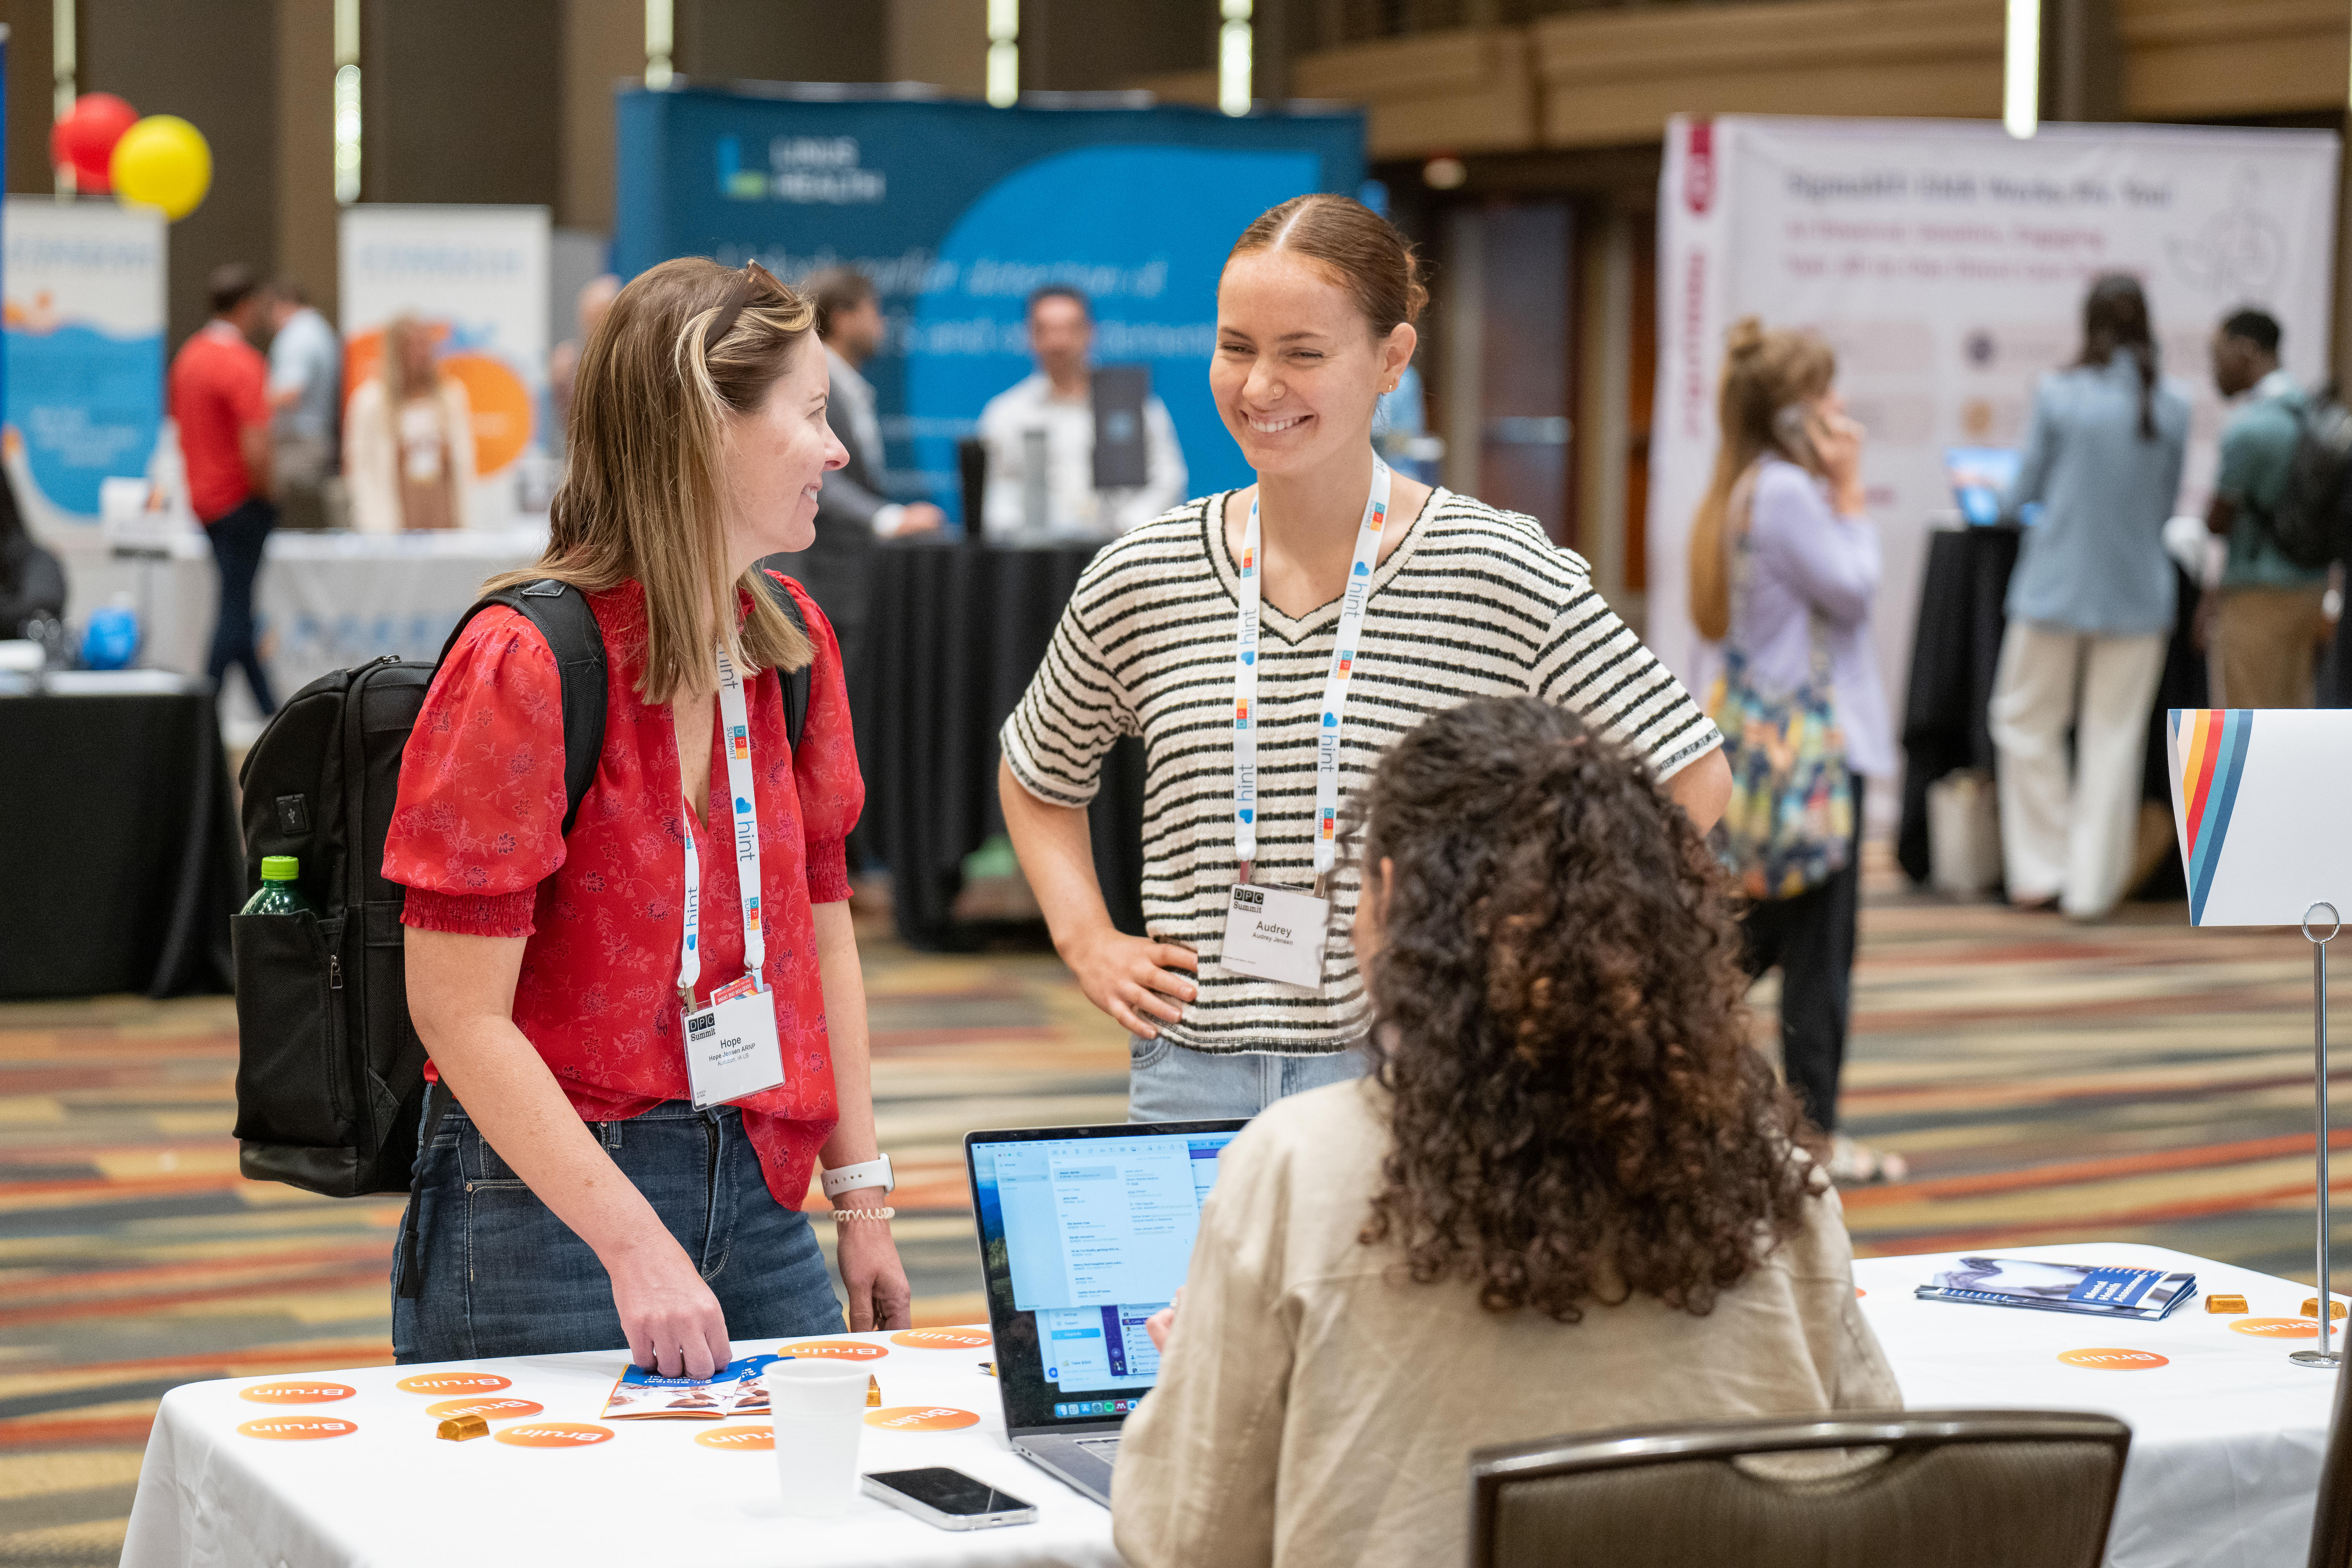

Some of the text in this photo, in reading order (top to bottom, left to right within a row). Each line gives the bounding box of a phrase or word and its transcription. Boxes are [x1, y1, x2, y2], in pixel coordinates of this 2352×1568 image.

[1345, 582, 1368, 618] hint
[1240, 608, 1256, 645] hint
[1332, 649, 1342, 679] SUMMIT
[726, 727, 736, 760] SUMMIT
[736, 727, 746, 758] DPC
[1321, 735, 1338, 773] hint
[1237, 764, 1254, 801] hint
[1325, 809, 1333, 838] DPC
[738, 820, 755, 862] hint
[1235, 889, 1263, 904] DPC
[686, 886, 697, 927] hint
[1233, 902, 1262, 913] Summit
[1256, 921, 1292, 938] Audrey
[1252, 932, 1293, 945] Audrey Jensen
[742, 983, 751, 992] GOOD
[717, 994, 728, 1003] DRINK
[690, 1015, 714, 1031] DPC
[691, 1028, 716, 1042] Summit
[720, 1037, 742, 1049] Hope
[709, 1043, 756, 1062] Hope Jensen ARNP
[717, 1057, 736, 1067] Audubon,
[2083, 1281, 2109, 1299] Mental
[2098, 1282, 2122, 1301] Health
[2112, 1274, 2148, 1303] Assessment
[907, 1330, 989, 1346] Bruin
[791, 1345, 878, 1355] Bruin
[2069, 1352, 2157, 1363] Bruin
[410, 1378, 500, 1388] Bruin
[441, 1400, 530, 1416] Bruin
[882, 1408, 960, 1428] Bruin
[250, 1423, 346, 1432] Bruin
[510, 1428, 599, 1442] Bruin
[706, 1431, 775, 1445] ruin
